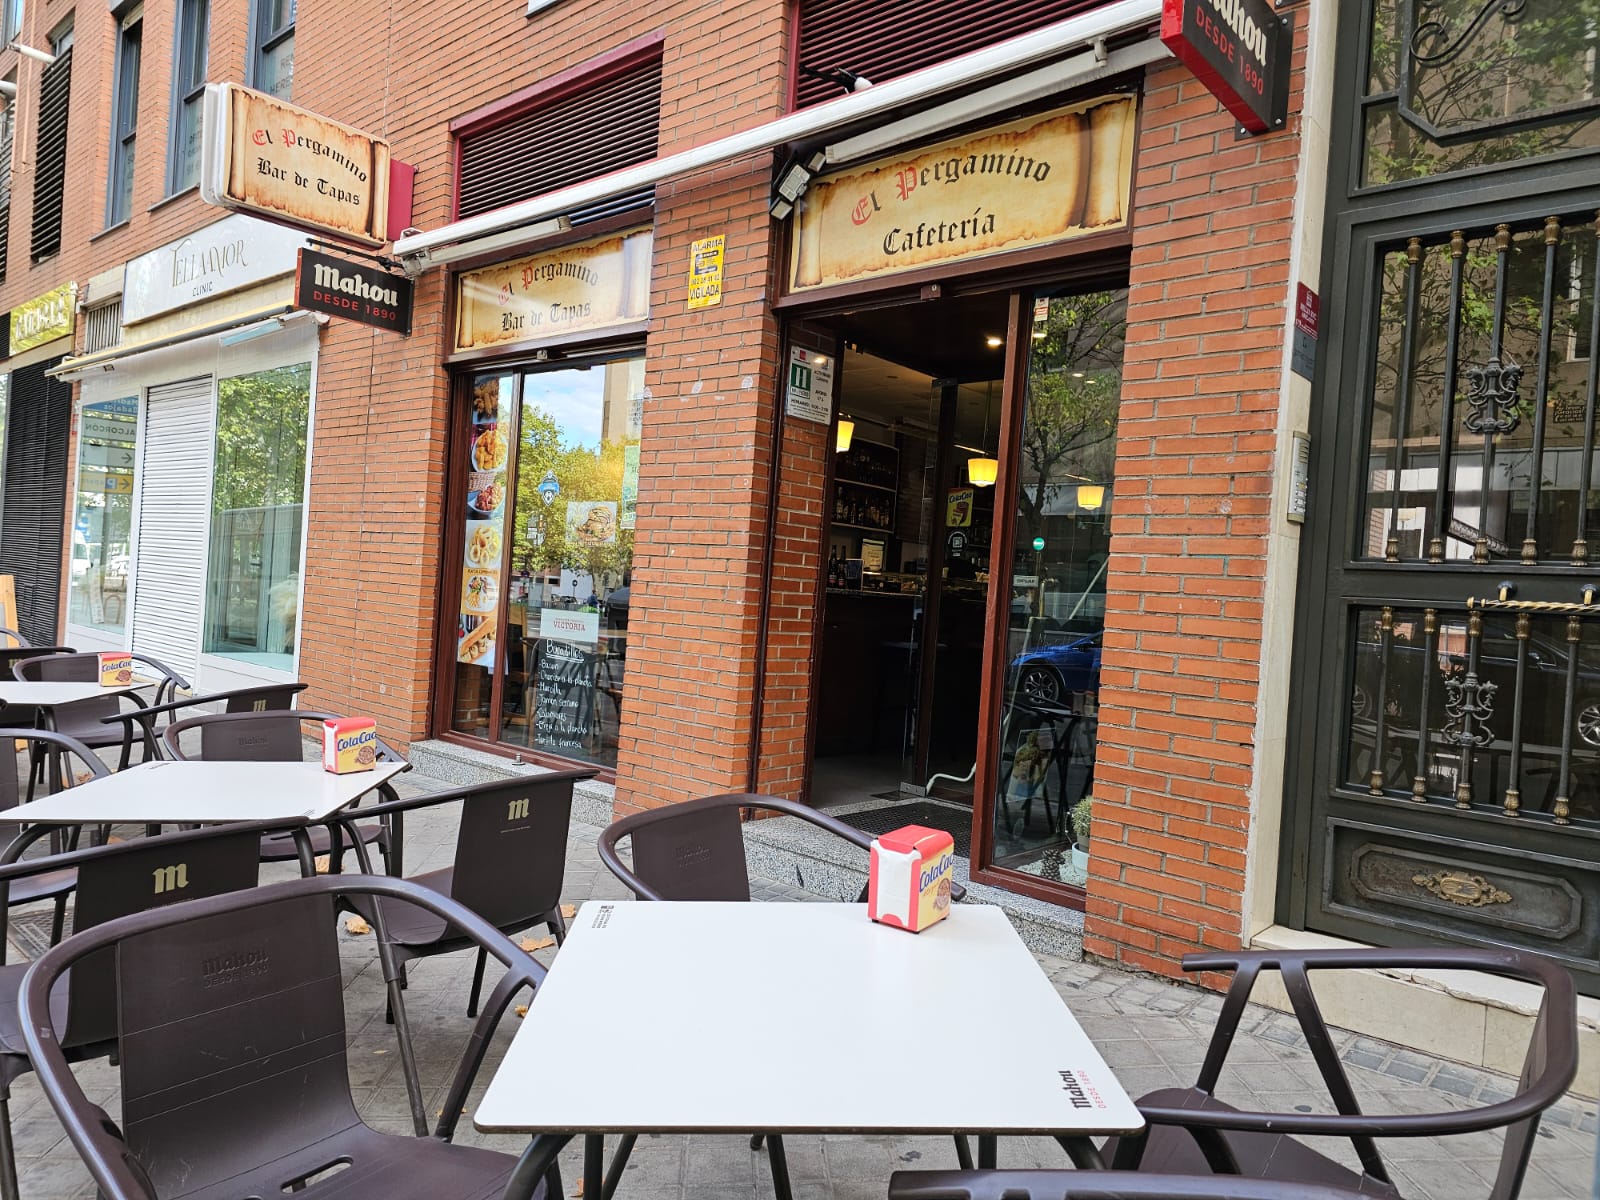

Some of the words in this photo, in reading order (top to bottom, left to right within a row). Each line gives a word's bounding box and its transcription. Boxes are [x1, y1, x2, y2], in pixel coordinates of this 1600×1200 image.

[1196, 6, 1235, 63] DESDE
[1240, 55, 1264, 95] 1890
[252, 129, 273, 146] El
[282, 128, 367, 182] Pergamino
[256, 157, 287, 181] Bar
[294, 170, 309, 189] de
[317, 178, 360, 206] Tapas
[851, 191, 881, 226] El
[896, 148, 1052, 201] Pergamino
[693, 238, 723, 253] ALARMA
[883, 207, 996, 255] Cafetería
[193, 281, 213, 297] CLINIC
[313, 263, 399, 307] Mahou
[498, 282, 514, 306] El
[522, 258, 599, 291] Pergamino
[690, 284, 720, 300] VIGILADA
[313, 290, 359, 311] DESDE
[365, 304, 397, 321] 1890
[501, 312, 525, 332] Bar
[530, 307, 544, 326] de
[550, 299, 592, 324] Tapas
[553, 620, 586, 632] VICTORIA
[102, 660, 132, 673] ColaCao
[337, 731, 377, 752] ColaCao
[919, 853, 955, 893] ColaCao
[1057, 1069, 1093, 1109] Mahou
